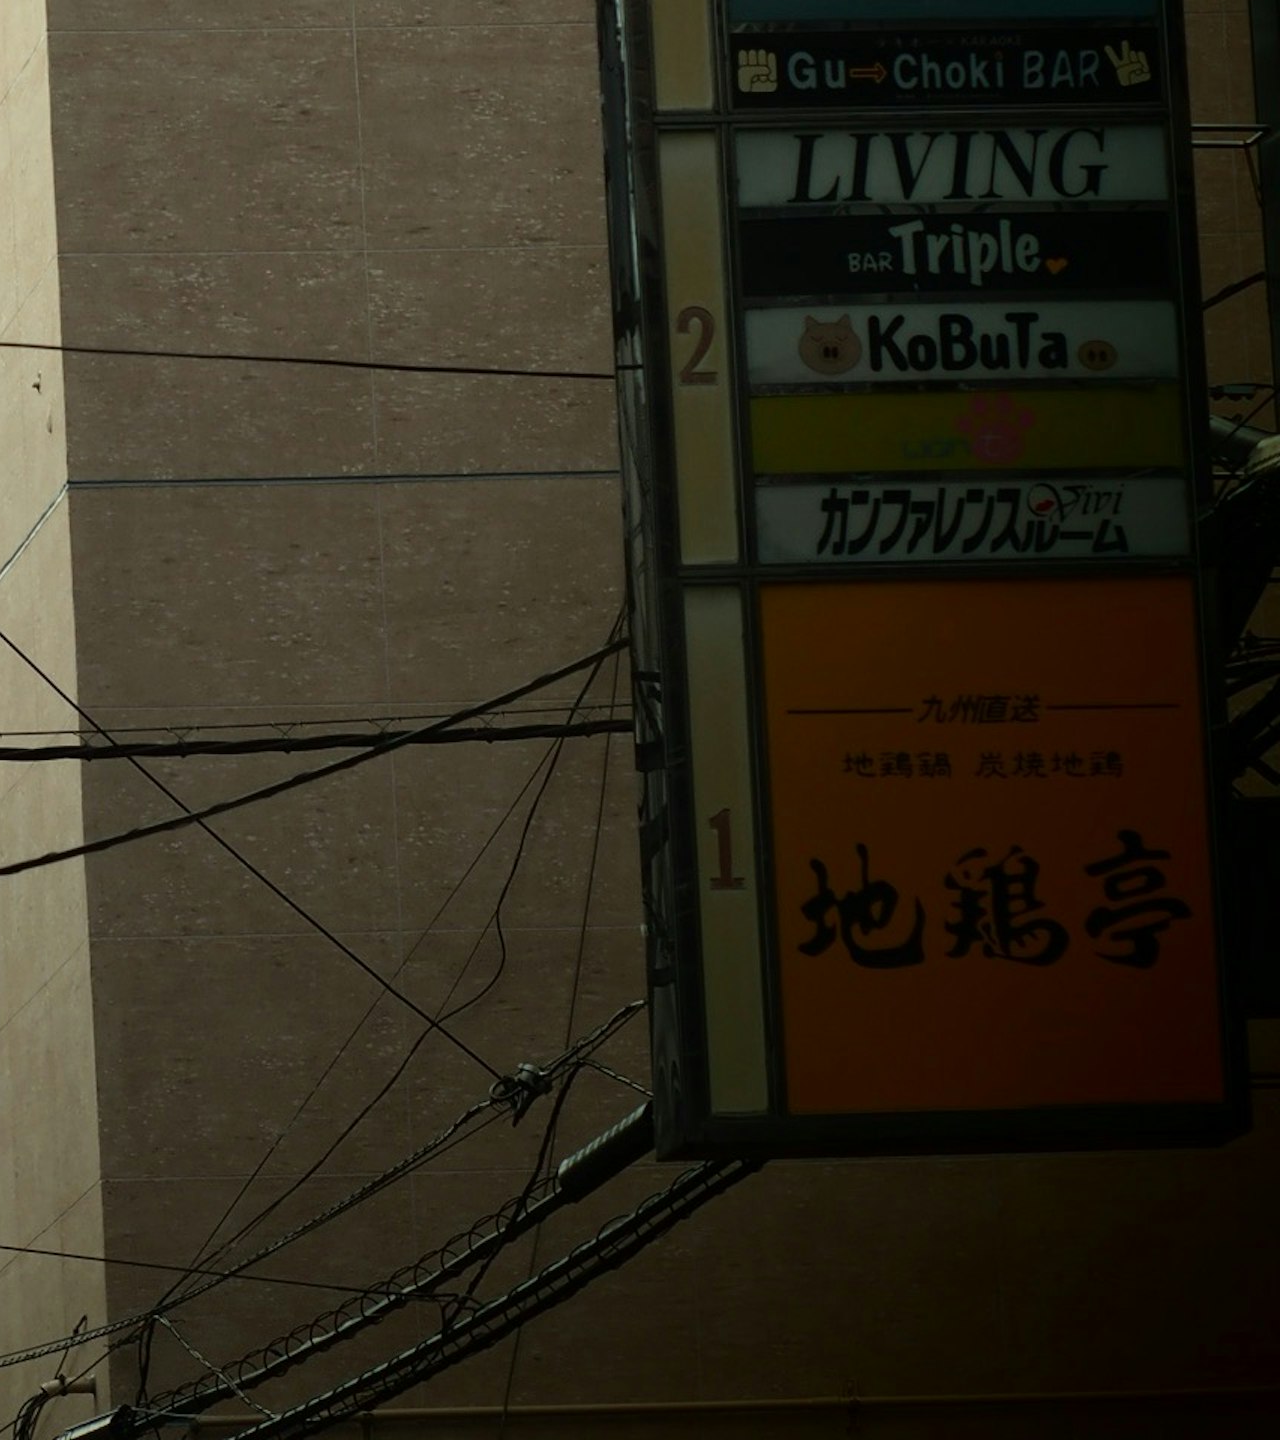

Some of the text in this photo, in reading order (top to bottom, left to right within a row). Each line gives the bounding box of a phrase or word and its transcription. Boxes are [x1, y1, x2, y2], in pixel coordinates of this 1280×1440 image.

[787, 47, 1102, 91] Gu Choki BAR
[788, 127, 1109, 203] LIVING
[847, 218, 1042, 288] BAR Triple
[675, 305, 719, 385] 2
[867, 312, 1069, 372] KoBuTa
[816, 488, 1130, 556] カンファレンスルーム
[917, 694, 1041, 724] 九州直送
[708, 808, 745, 891] 1
[798, 829, 1192, 970] 地鶏亭
